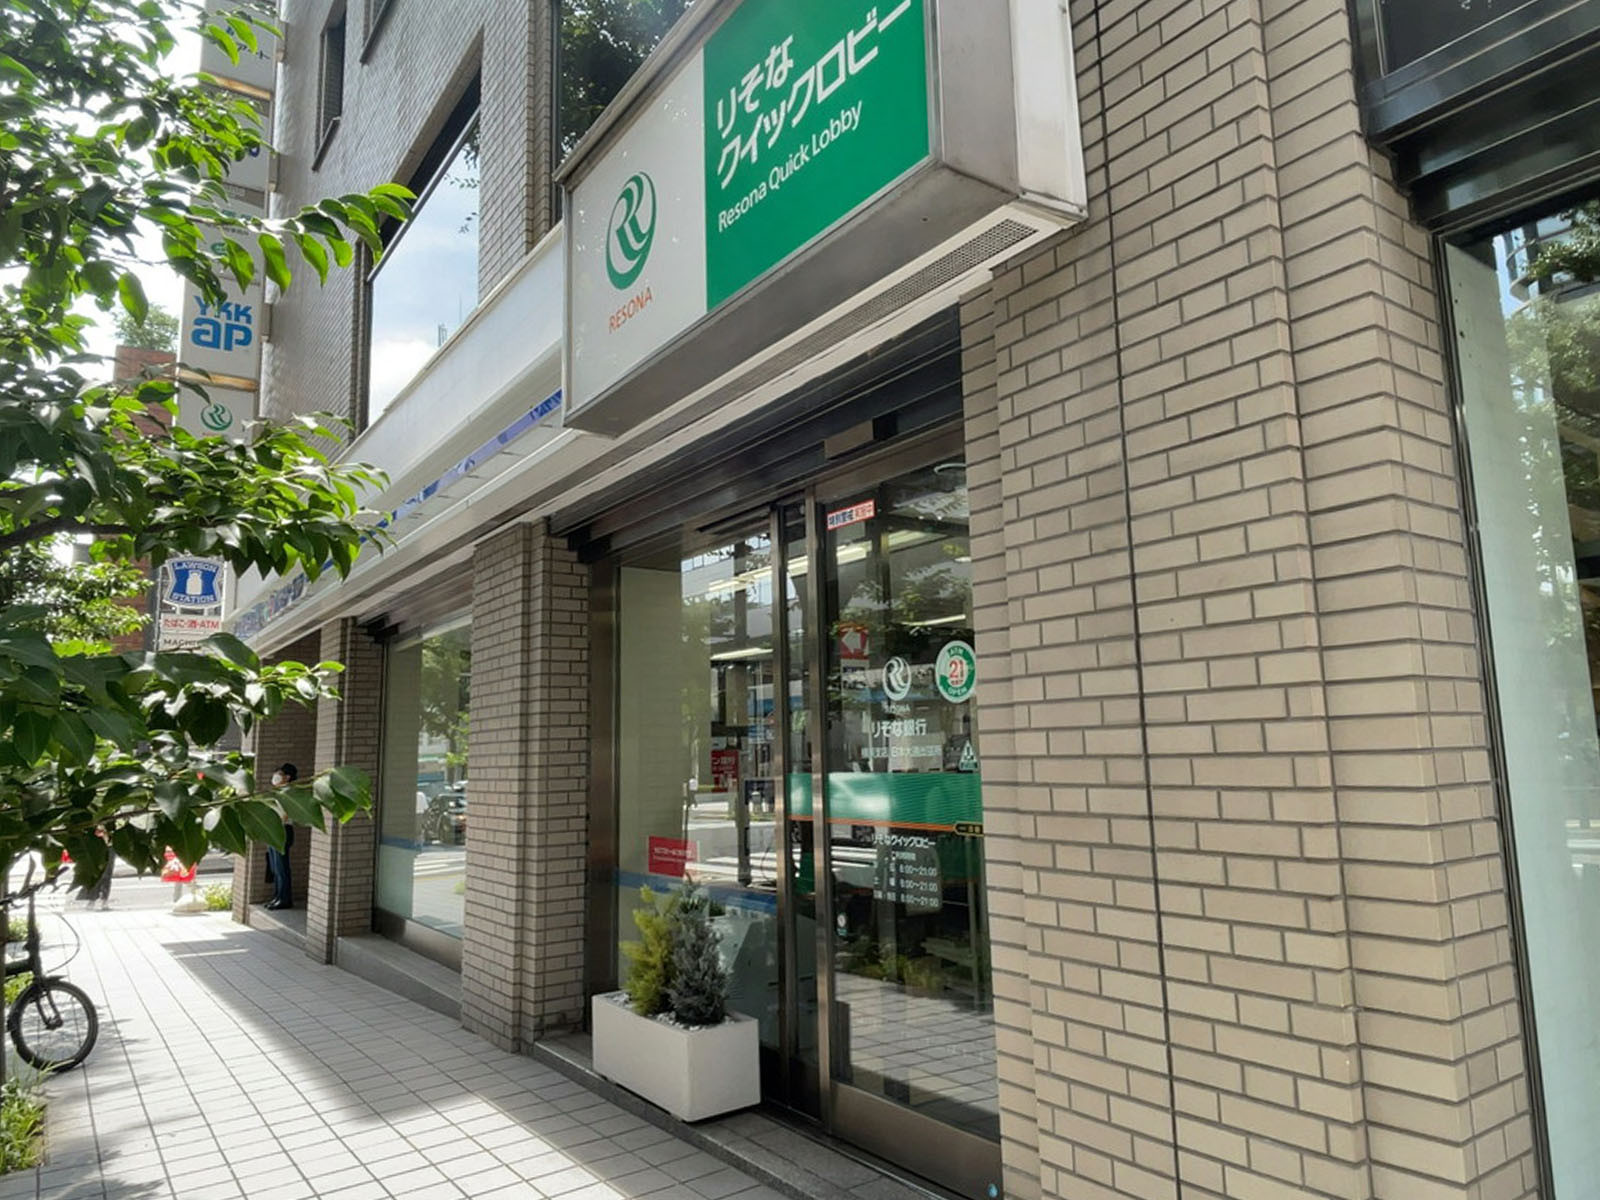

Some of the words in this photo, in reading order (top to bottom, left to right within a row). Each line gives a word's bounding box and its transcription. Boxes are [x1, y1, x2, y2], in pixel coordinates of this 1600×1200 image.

[717, 34, 794, 139] りそな
[717, 0, 911, 190] クイックロビー
[718, 181, 767, 233] Resona
[769, 143, 810, 190] Quick
[812, 100, 862, 157] Lobby
[193, 295, 253, 325] YKK
[608, 286, 653, 334] RESONA
[190, 316, 253, 352] ap
[173, 562, 219, 574] LAWSON
[171, 592, 215, 604] STATION
[872, 718, 928, 738] りそな銀行
